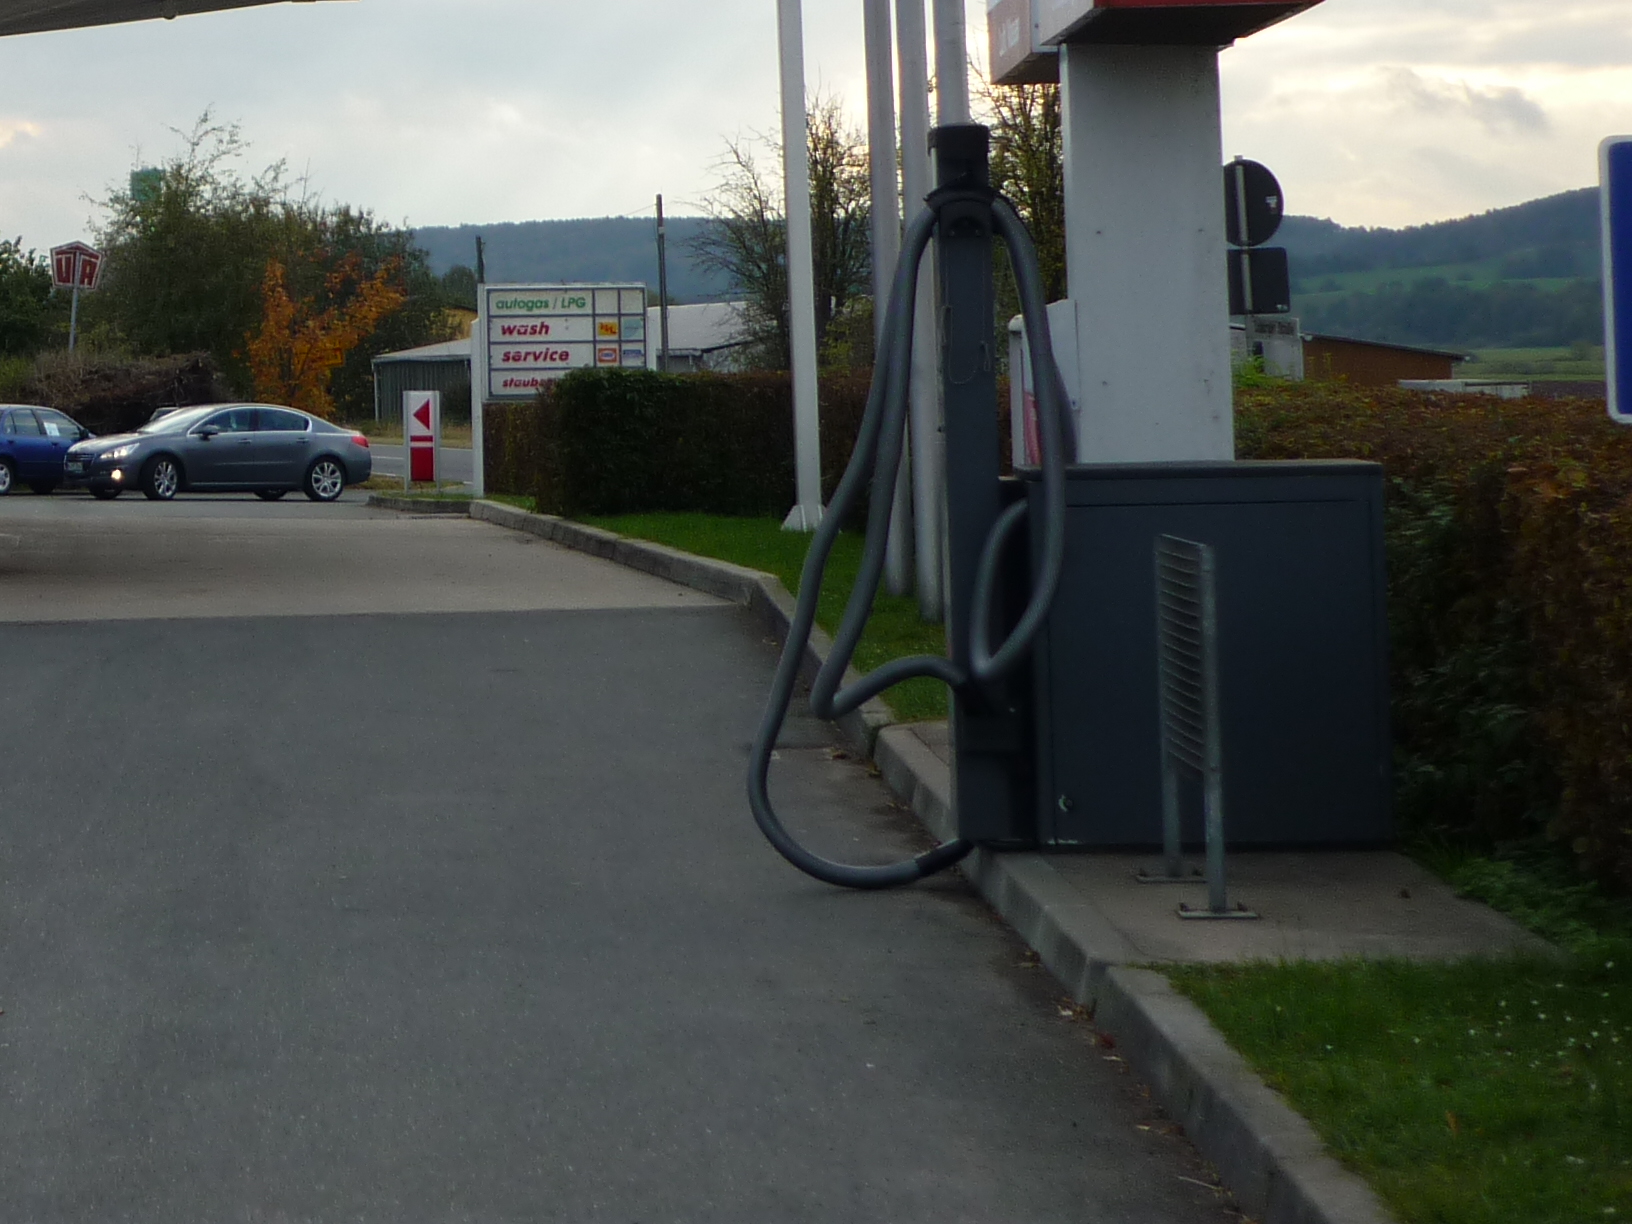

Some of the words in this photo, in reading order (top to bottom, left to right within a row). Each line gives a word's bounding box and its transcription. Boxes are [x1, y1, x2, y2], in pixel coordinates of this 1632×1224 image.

[495, 297, 549, 312] autogas
[561, 297, 586, 309] LPG
[501, 321, 550, 336] wash
[502, 347, 570, 363] service
